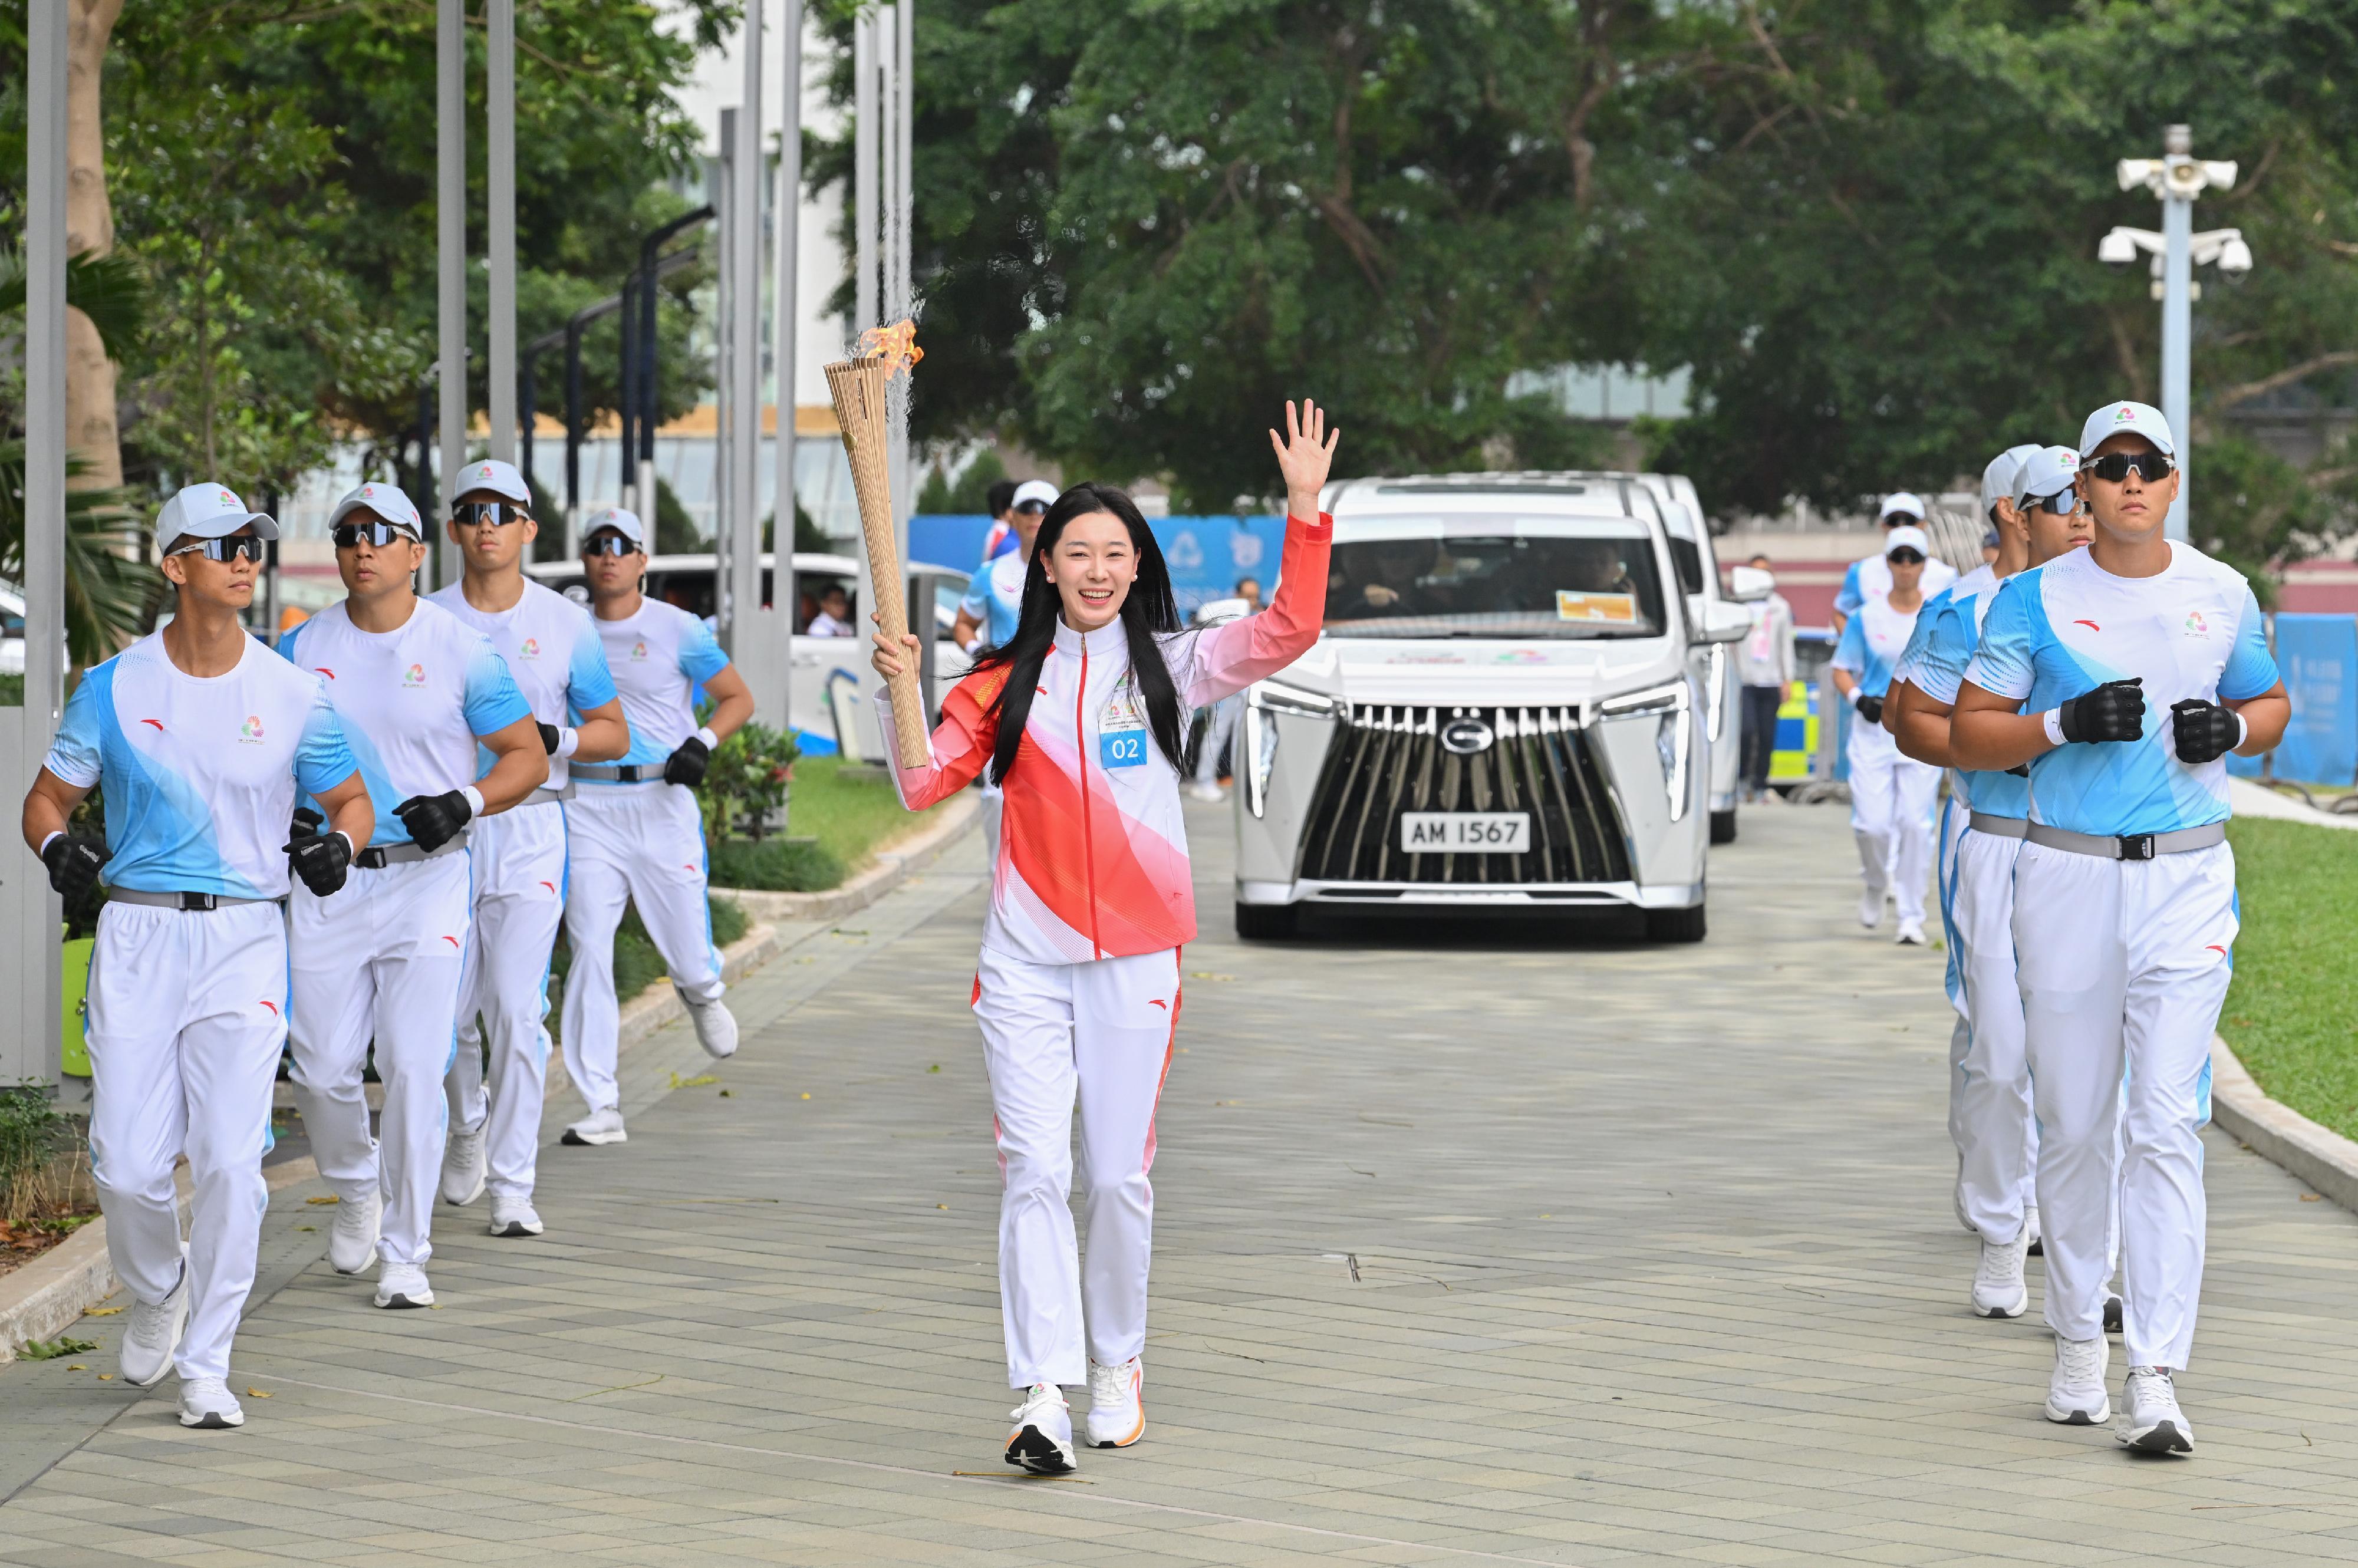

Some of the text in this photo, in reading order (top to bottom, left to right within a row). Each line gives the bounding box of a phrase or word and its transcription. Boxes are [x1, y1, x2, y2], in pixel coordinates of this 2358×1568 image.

[1112, 739, 1138, 759] 02
[1411, 821, 1520, 844] AM 1567
